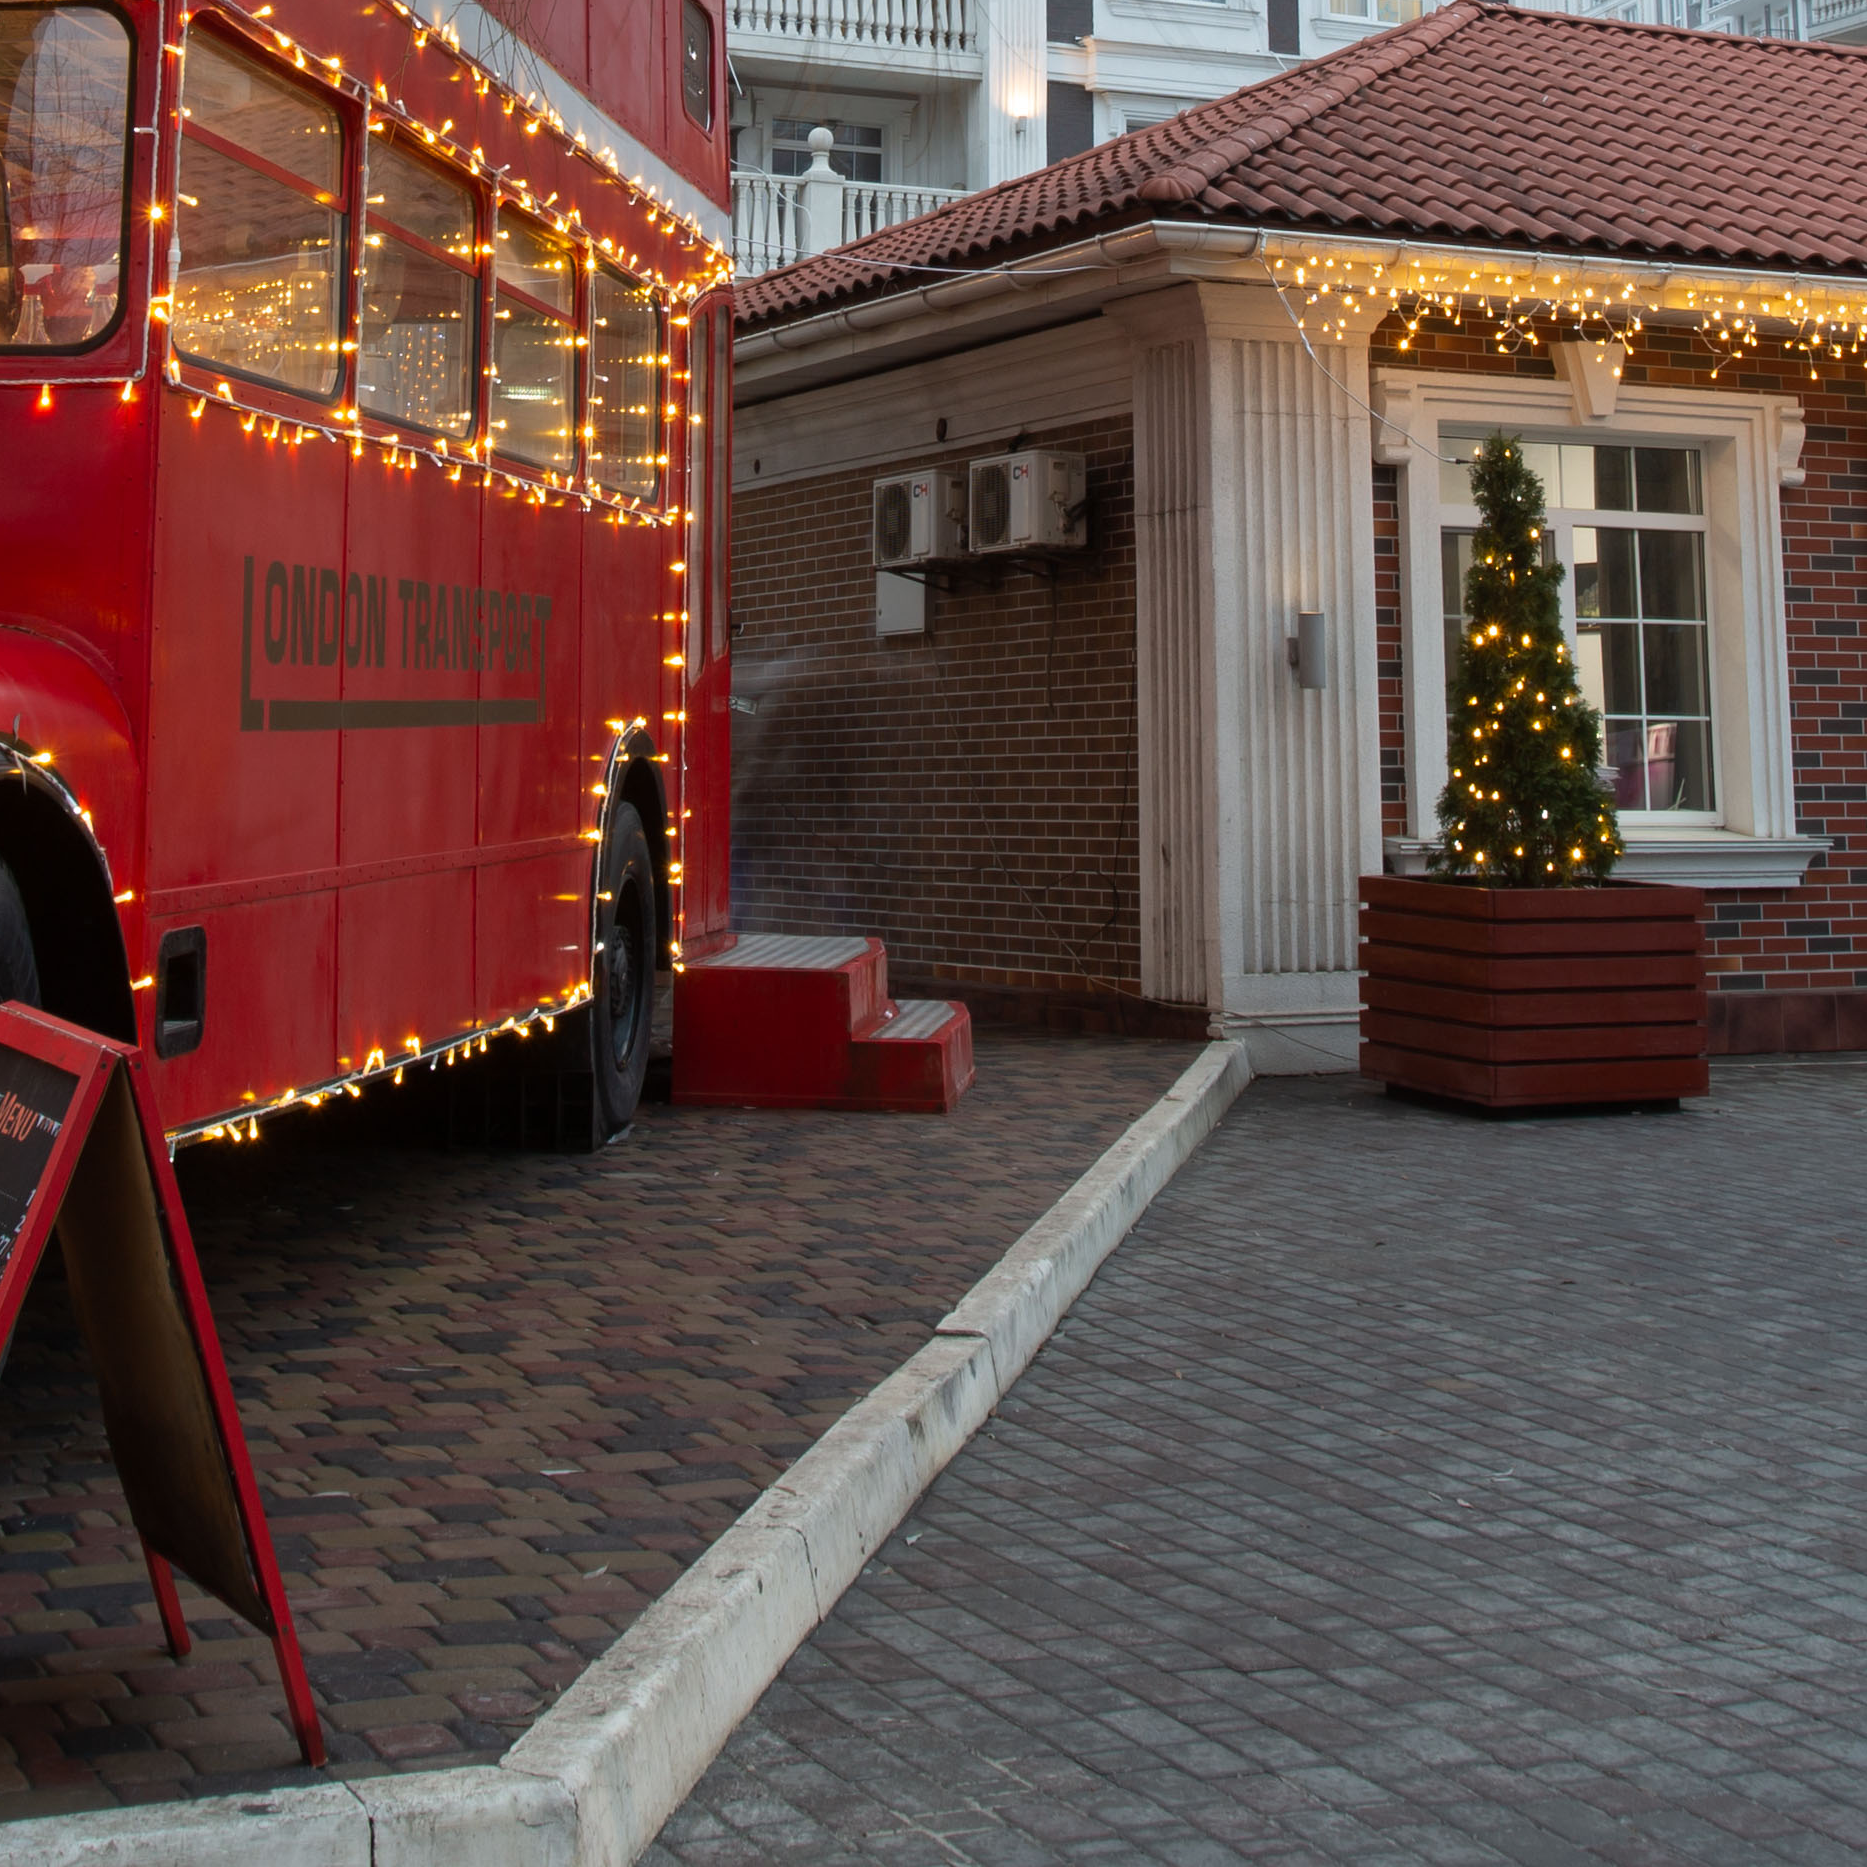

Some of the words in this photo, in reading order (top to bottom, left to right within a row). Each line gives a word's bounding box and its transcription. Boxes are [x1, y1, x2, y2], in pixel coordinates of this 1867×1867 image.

[1013, 464, 1029, 480] CH
[912, 483, 929, 498] CH
[239, 555, 388, 732] LONDON
[398, 577, 553, 724] TRANSPORT
